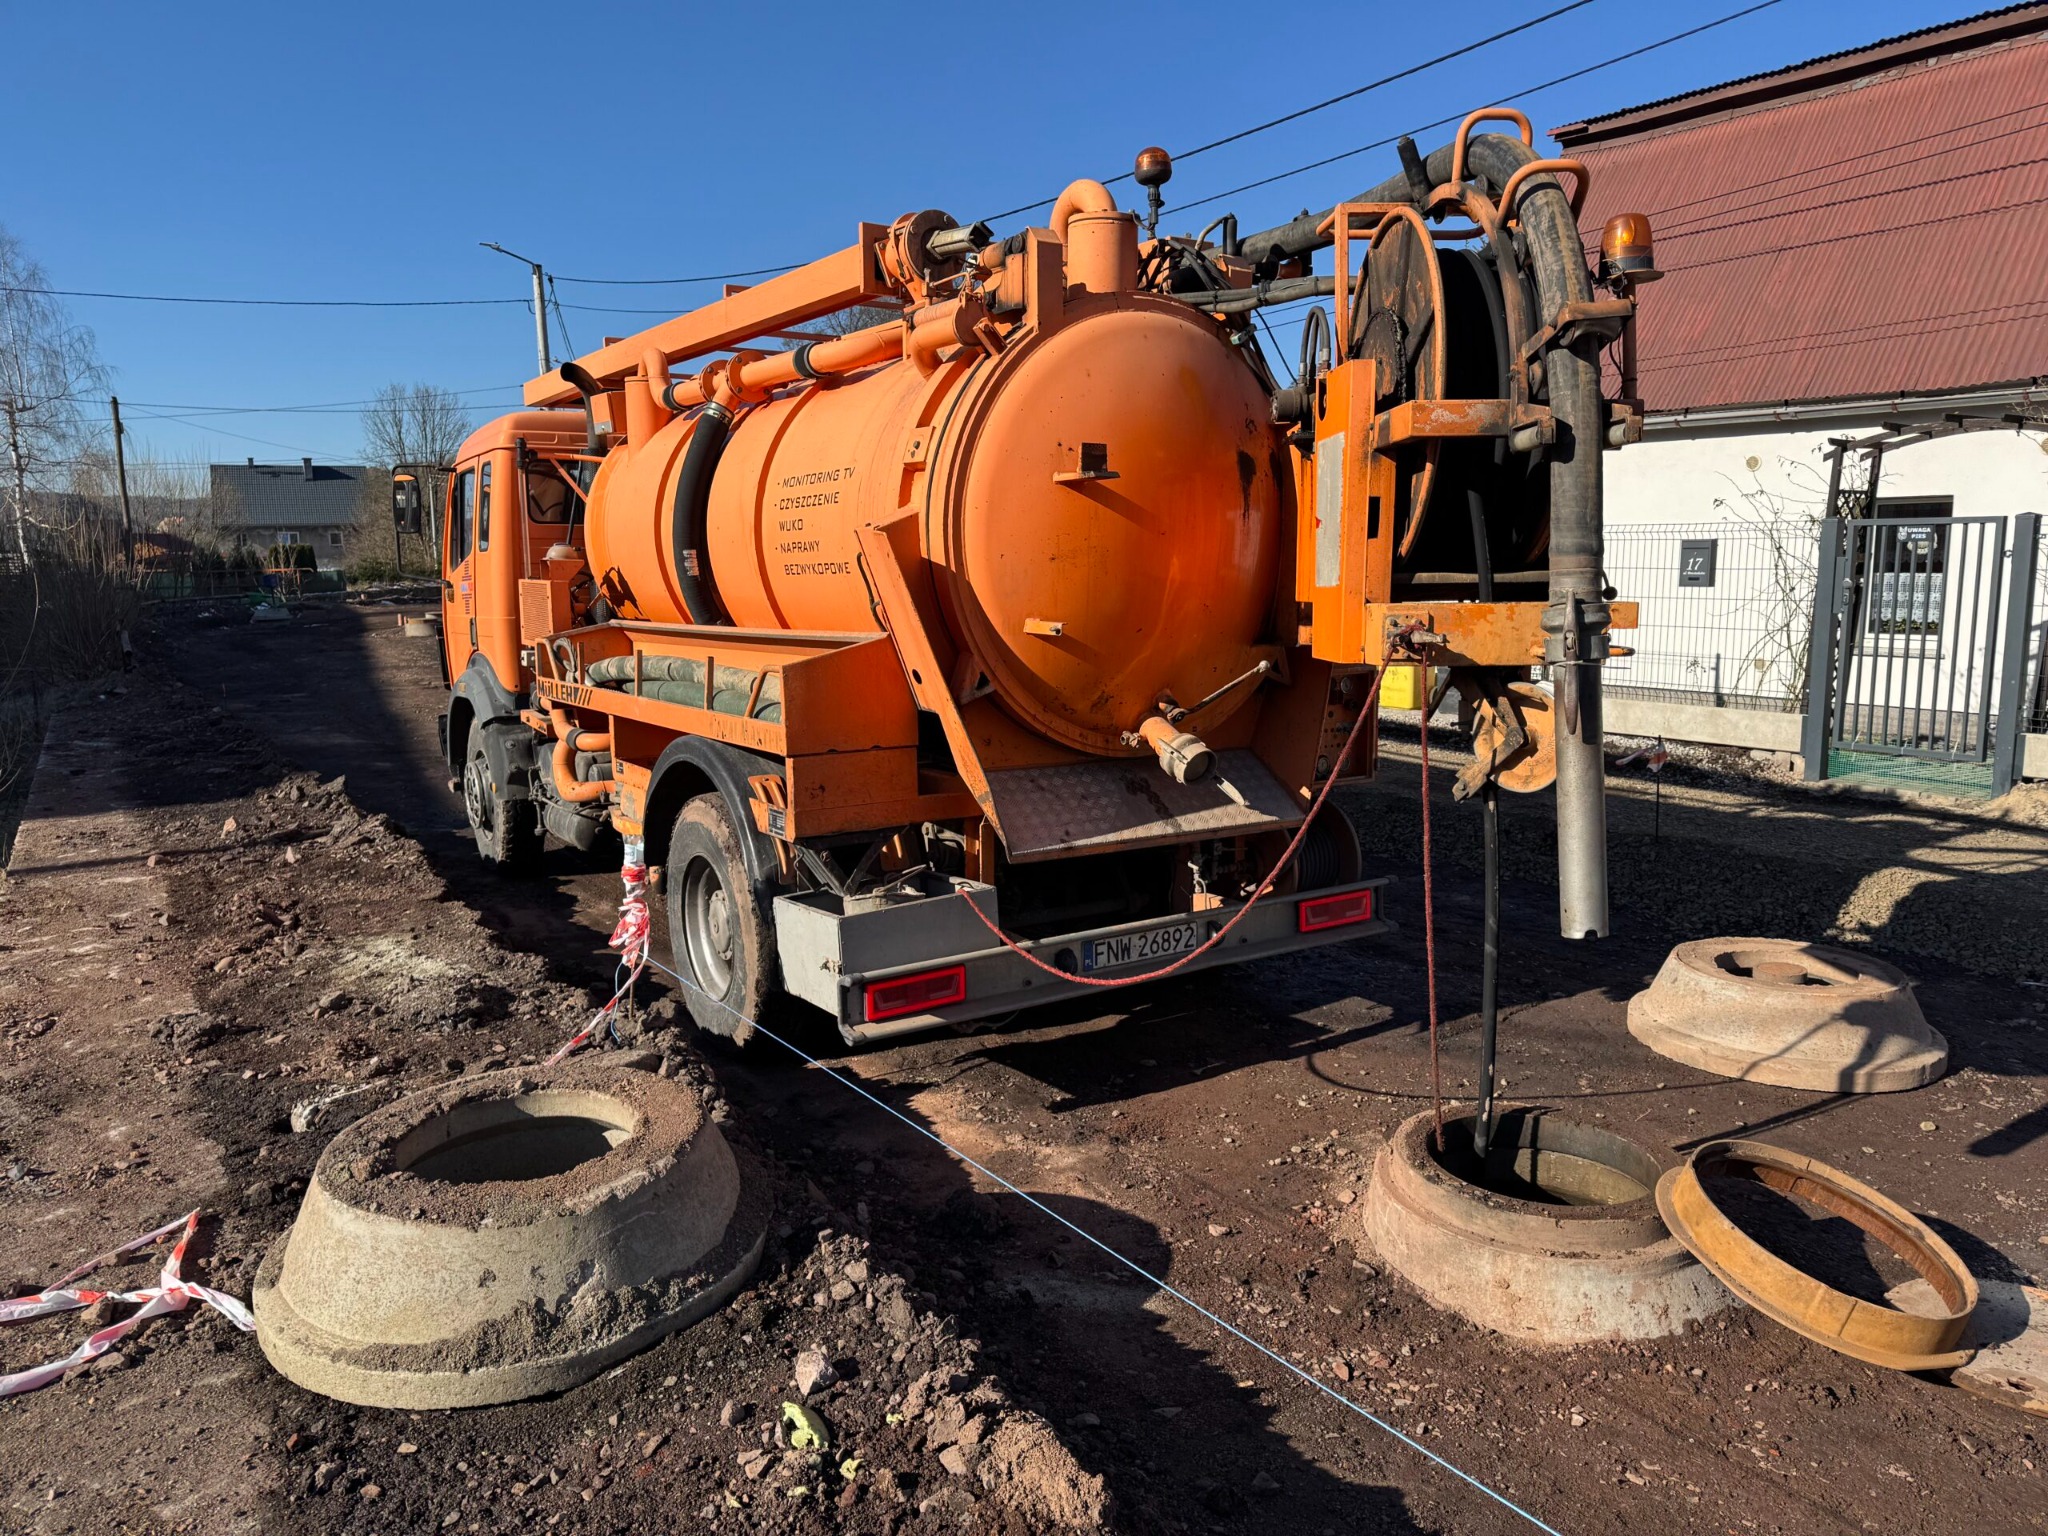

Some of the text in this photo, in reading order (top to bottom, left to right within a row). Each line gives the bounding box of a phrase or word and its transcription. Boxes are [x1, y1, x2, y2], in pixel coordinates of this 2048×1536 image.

[782, 466, 856, 489] MONITORING TV
[779, 491, 840, 510] CZYSZCZENIE
[778, 518, 804, 532] WUKO
[780, 540, 820, 554] NAPRAWY
[784, 562, 851, 576] BEZWYKOPOWE
[1686, 558, 1704, 571] 17
[1094, 926, 1195, 966] FNW 26892
